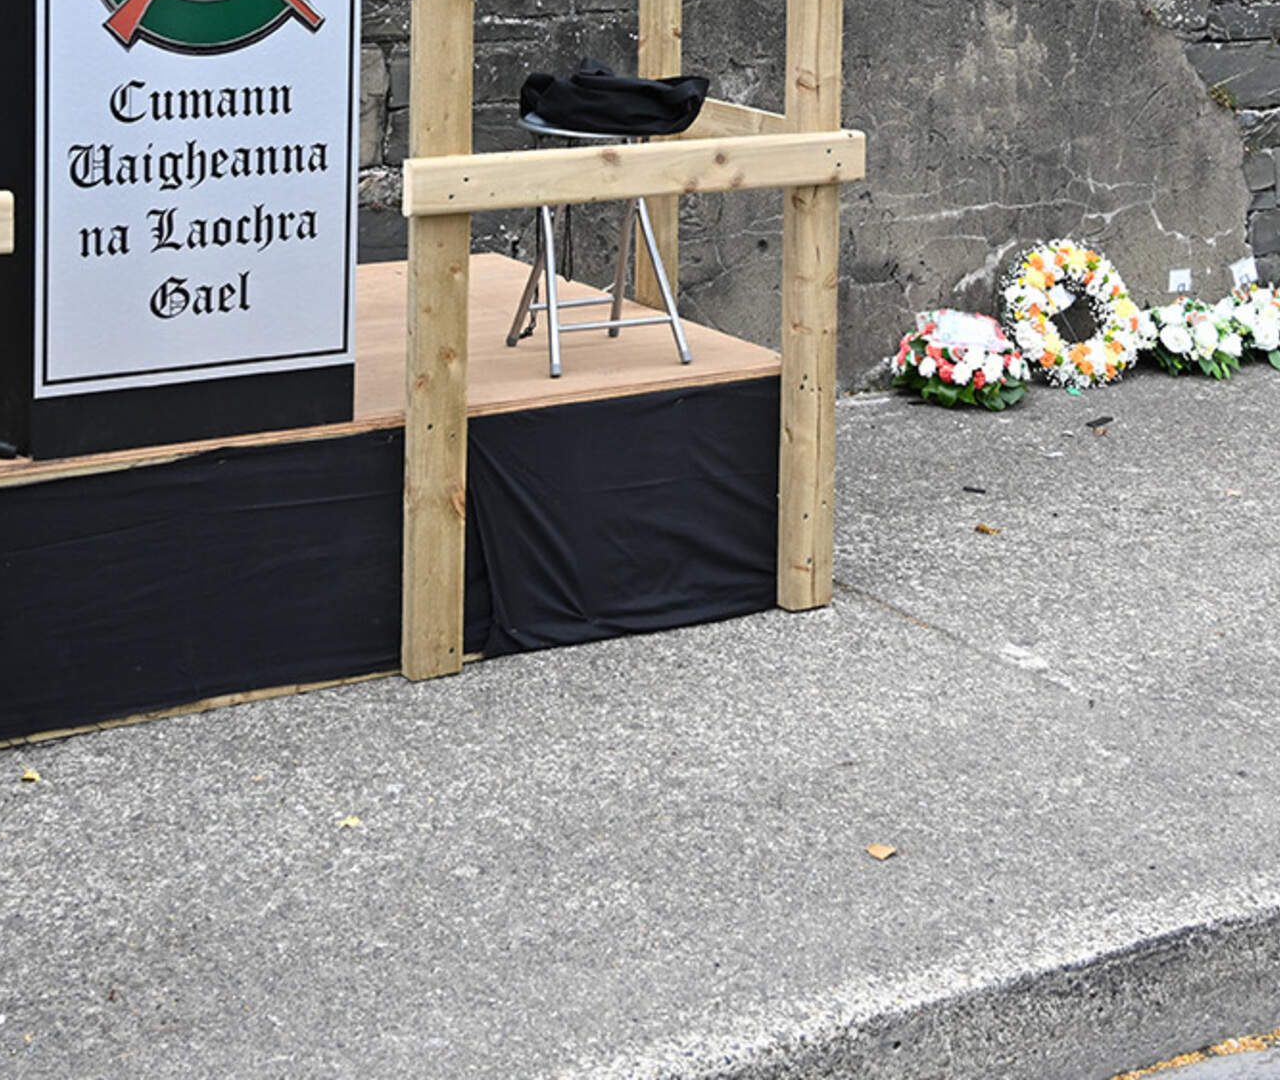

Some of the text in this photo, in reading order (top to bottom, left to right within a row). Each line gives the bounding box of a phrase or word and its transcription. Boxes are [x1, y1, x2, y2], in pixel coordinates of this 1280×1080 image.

[109, 80, 292, 124] Cumann
[68, 139, 328, 191] Uaigheanna
[80, 203, 318, 258] na Laochra
[150, 270, 251, 319] Gael
